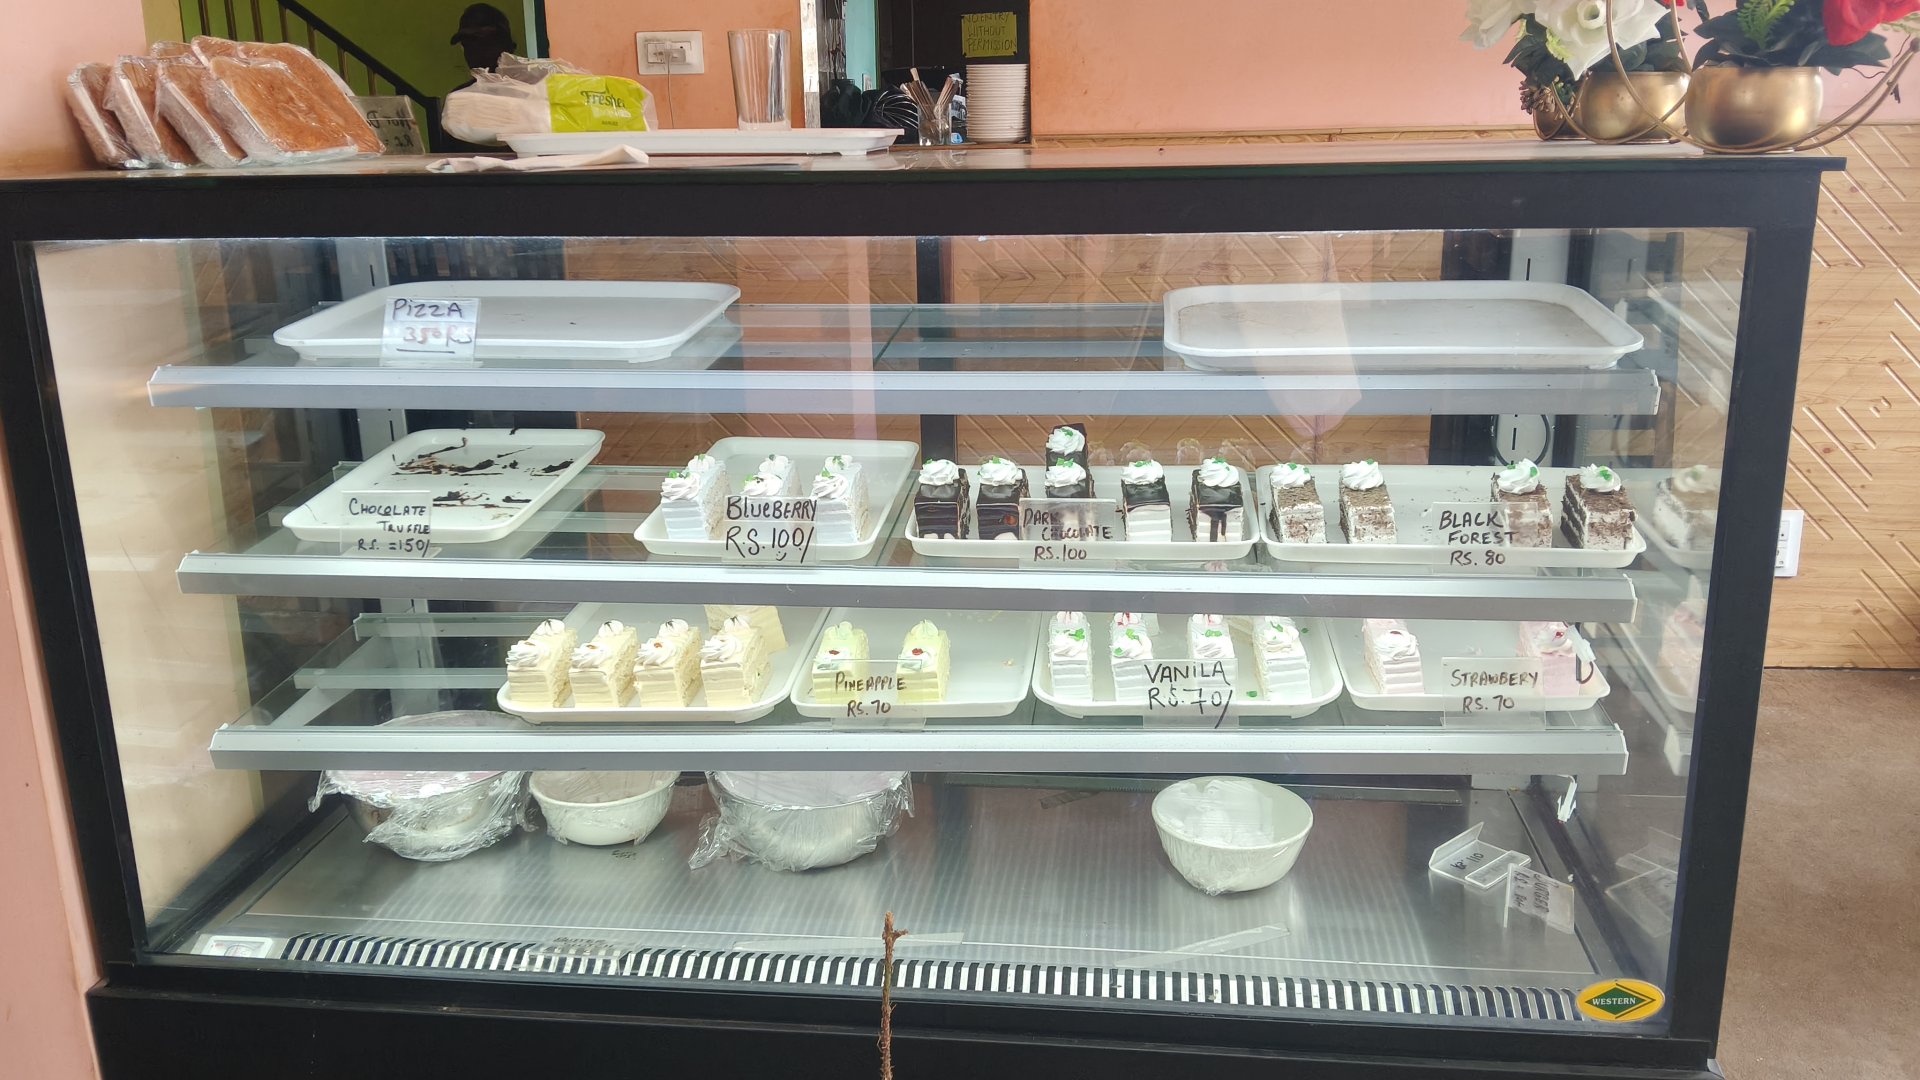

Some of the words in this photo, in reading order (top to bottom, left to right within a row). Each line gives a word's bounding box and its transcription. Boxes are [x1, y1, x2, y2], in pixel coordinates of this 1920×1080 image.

[349, 498, 427, 517] CHOCOLATE
[376, 520, 431, 535] TRUFFLE
[1023, 508, 1061, 528] DARK
[1439, 510, 1504, 530] BLACK
[1448, 530, 1519, 545] FOREST
[1485, 550, 1506, 566] 80
[835, 671, 907, 693] PINEAPPLE
[1451, 669, 1538, 688] STRAWBERY
[1592, 997, 1636, 1006] WESTERN
